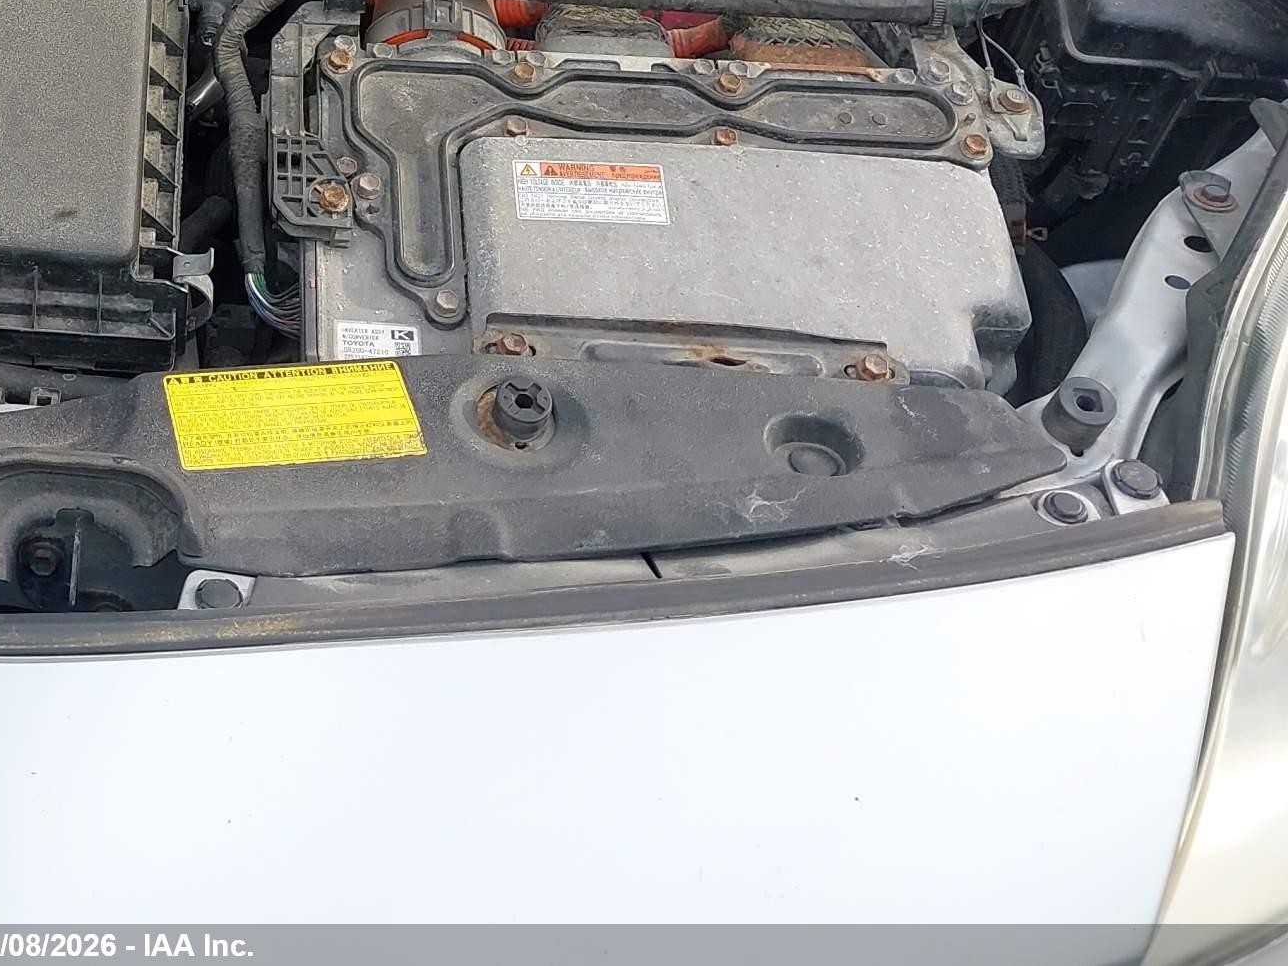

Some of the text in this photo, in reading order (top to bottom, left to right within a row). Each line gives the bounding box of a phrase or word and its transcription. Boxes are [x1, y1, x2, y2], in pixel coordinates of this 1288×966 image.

[559, 163, 595, 172] WARNING
[209, 371, 258, 383] CAUTION
[264, 367, 327, 380] ATTENTION
